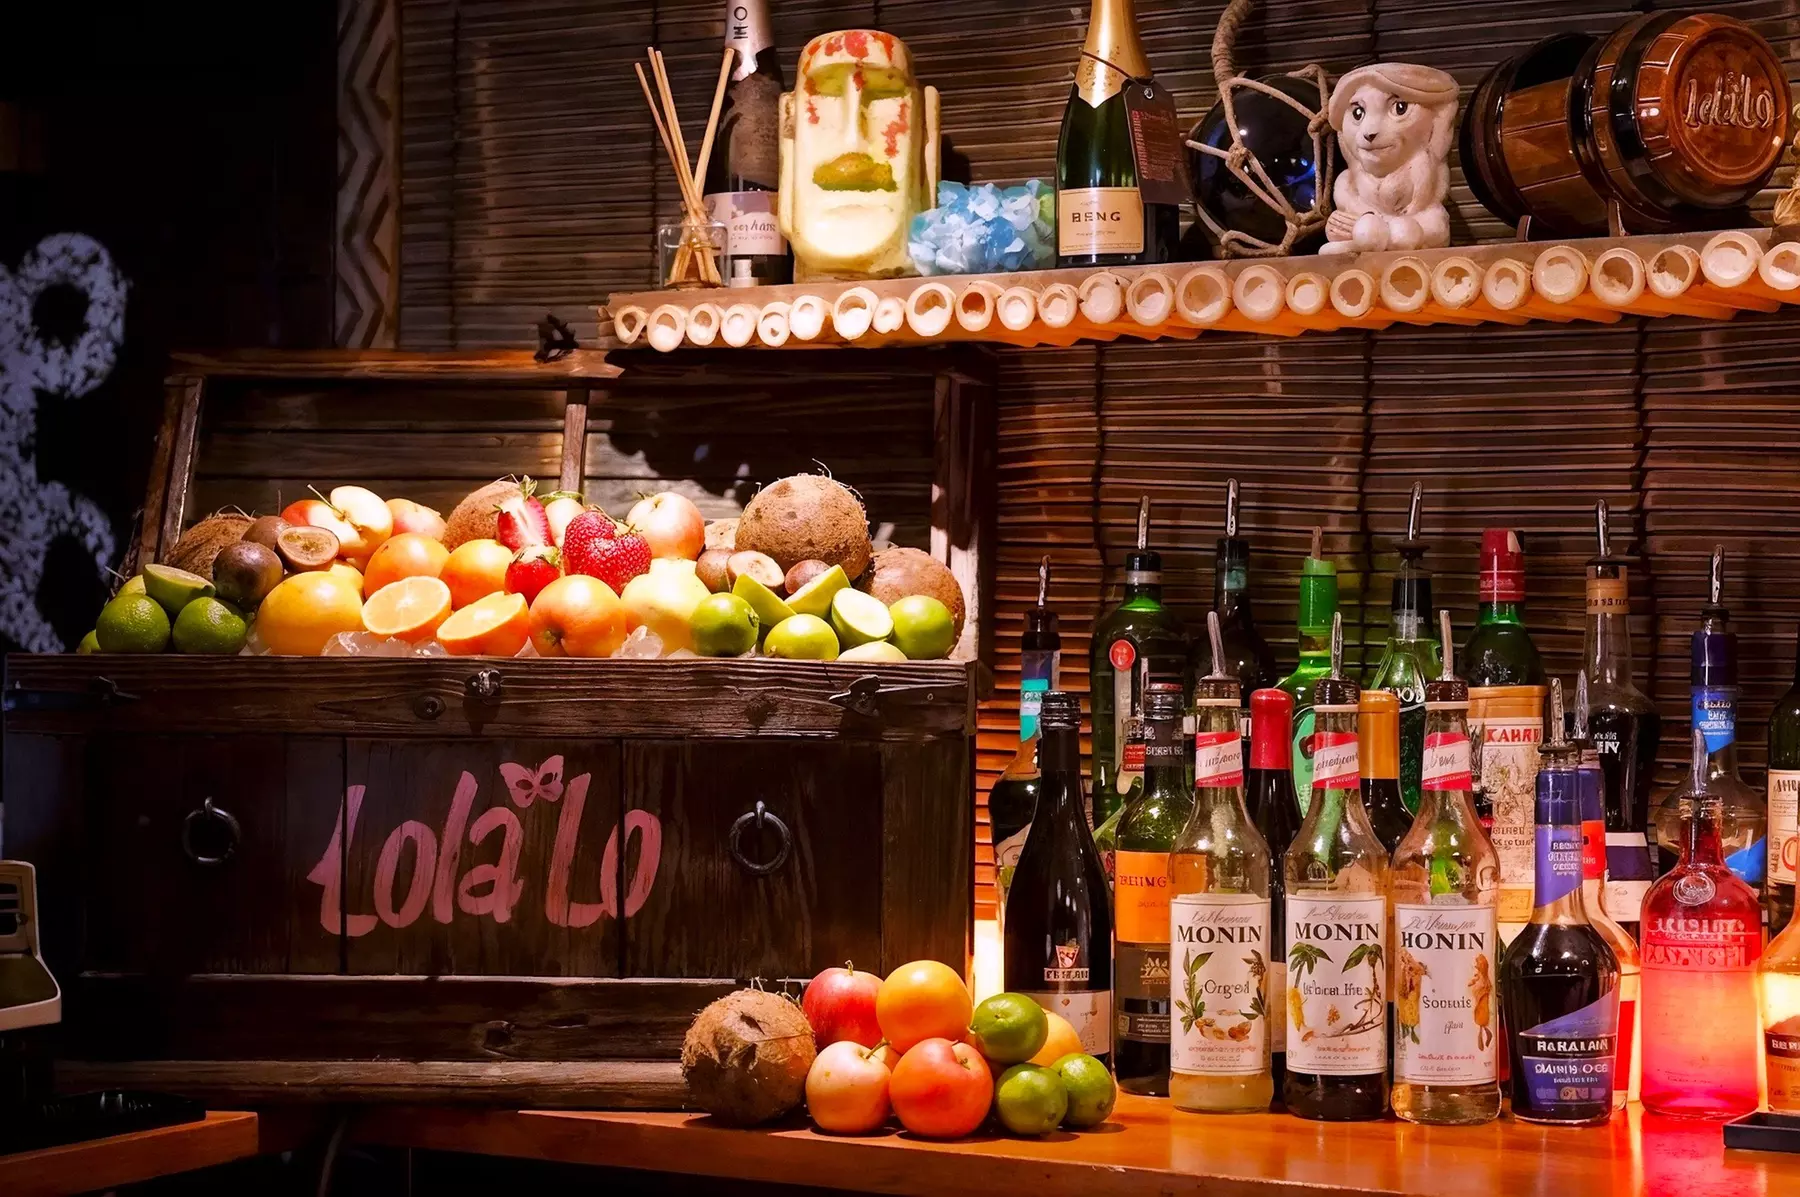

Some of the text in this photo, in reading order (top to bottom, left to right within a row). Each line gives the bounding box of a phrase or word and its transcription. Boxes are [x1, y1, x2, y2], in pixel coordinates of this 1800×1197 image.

[307, 770, 662, 937] Lola Lo
[1177, 925, 1262, 944] MONIN
[1295, 922, 1379, 941] MONIN
